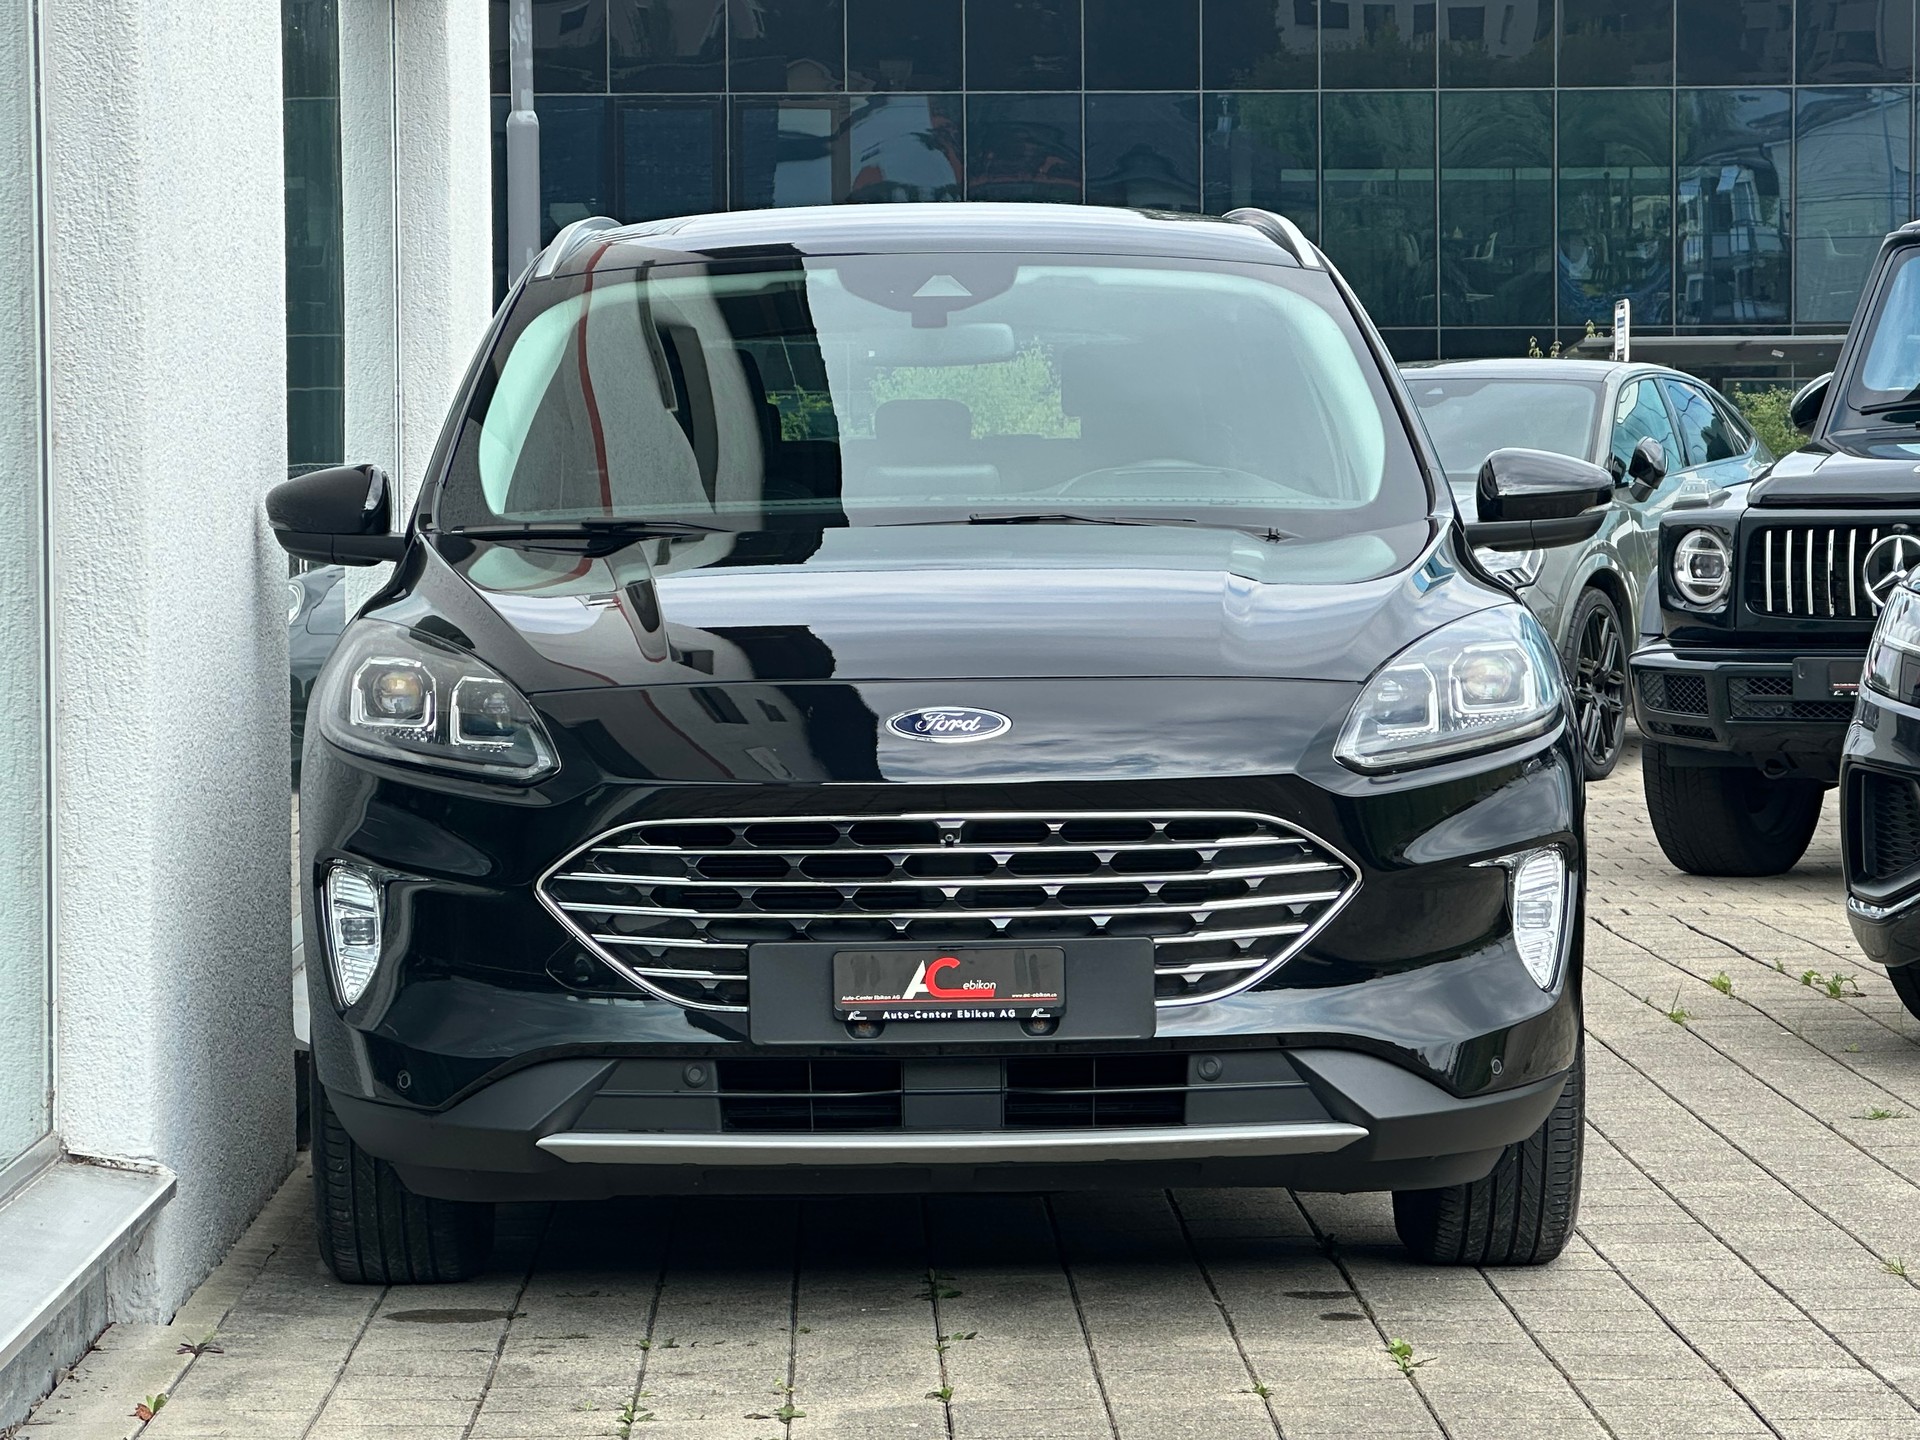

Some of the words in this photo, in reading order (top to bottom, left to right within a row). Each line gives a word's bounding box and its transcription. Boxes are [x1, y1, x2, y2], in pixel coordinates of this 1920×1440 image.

[915, 711, 981, 732] Ford
[963, 980, 997, 990] ebikon
[882, 1010, 952, 1020] Auto-Center
[956, 1009, 995, 1018] Ebikon
[1000, 1009, 1016, 1018] AG
